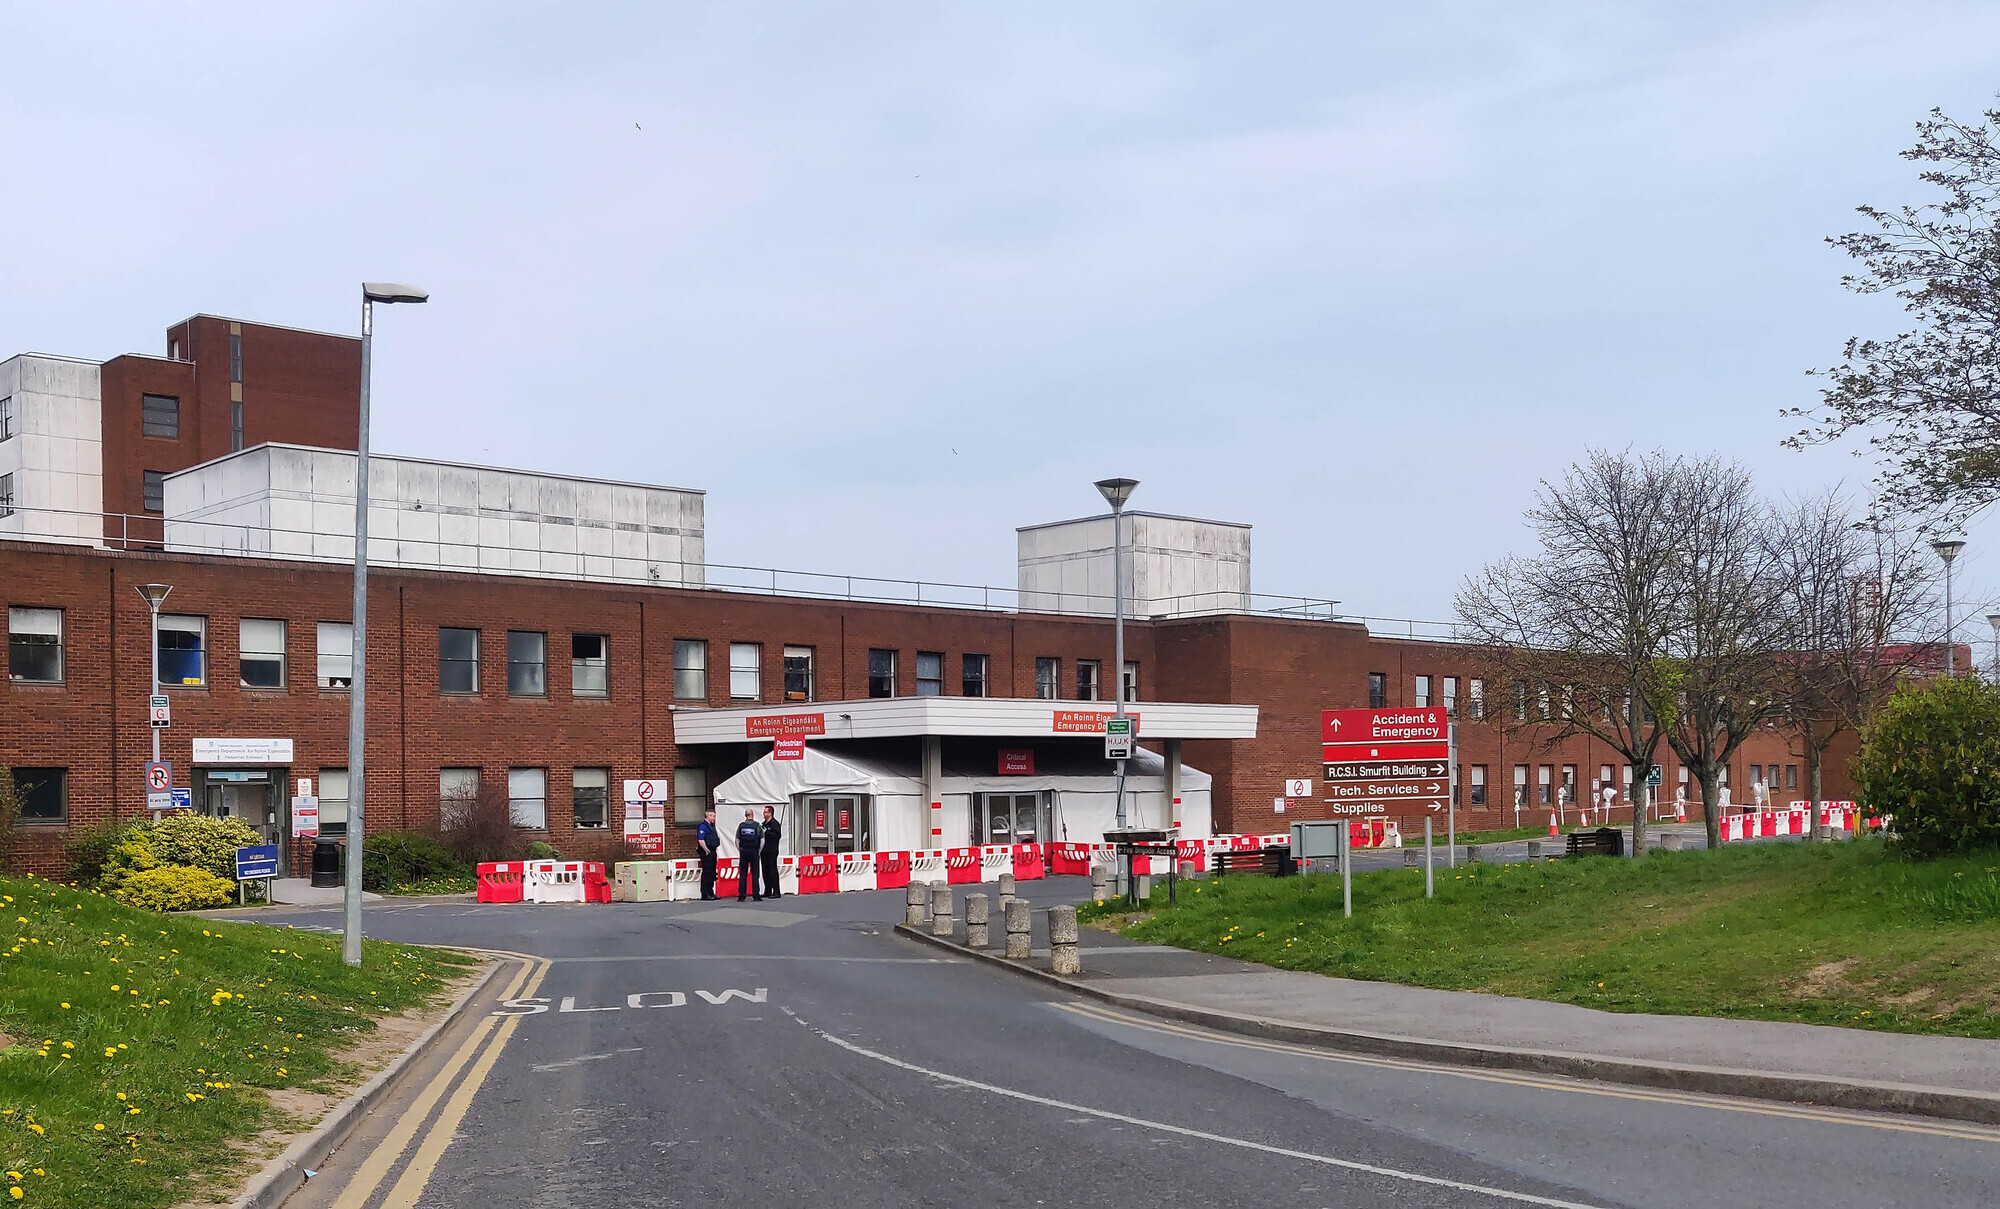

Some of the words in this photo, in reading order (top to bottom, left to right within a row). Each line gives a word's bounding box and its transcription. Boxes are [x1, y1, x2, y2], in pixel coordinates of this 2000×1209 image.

[156, 708, 165, 719] G
[1062, 713, 1072, 721] An
[1074, 713, 1095, 721] Roinn
[1372, 714, 1424, 724] Accident
[1428, 713, 1437, 723] &
[763, 718, 781, 726] Roinn
[1057, 722, 1096, 732] Emergency
[749, 726, 784, 736] Emergency
[784, 725, 821, 735] Department
[1372, 727, 1439, 738] Emergency
[777, 749, 800, 757] Entrance
[1328, 766, 1358, 778] R.C.S.I.
[1359, 764, 1391, 777] Smurfit
[1392, 764, 1428, 777] Building
[1332, 785, 1365, 796] Tech.
[1368, 784, 1419, 795] Services
[1333, 802, 1385, 814] Supplies
[491, 987, 768, 1016] SLOW
